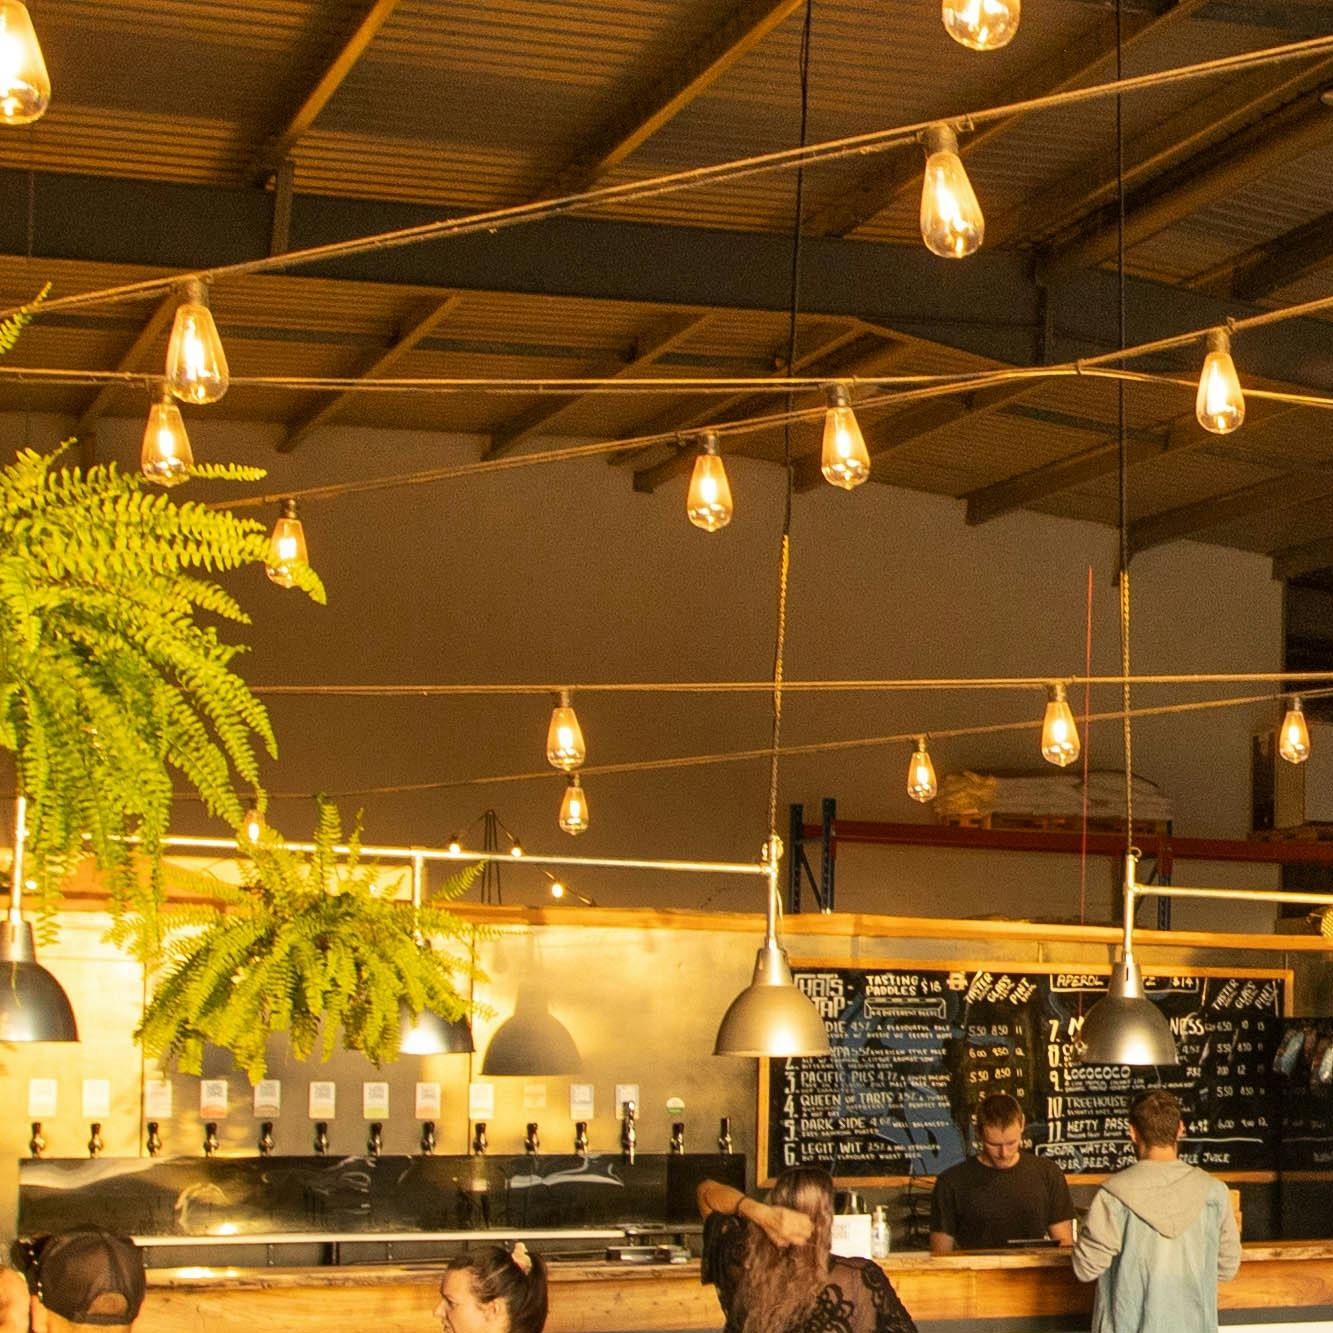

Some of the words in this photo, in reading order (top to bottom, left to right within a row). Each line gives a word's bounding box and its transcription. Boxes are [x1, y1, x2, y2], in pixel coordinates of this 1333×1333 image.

[866, 975, 919, 986] TASTING
[1056, 975, 1104, 987] APEROL
[866, 986, 917, 996] PADDLES
[964, 972, 994, 1004] TASTER
[987, 975, 1011, 1003] GLASS
[1009, 977, 1030, 1005] PINT
[1211, 979, 1239, 1010] TASTER
[1254, 983, 1273, 1009] PINT
[801, 1071, 847, 1084] PACIFIC
[852, 1071, 876, 1082] PILS
[801, 1094, 841, 1106] QUEEN
[859, 1092, 894, 1105] TARTS
[1066, 1096, 1128, 1109] TREEHOUSE
[801, 1118, 833, 1131] DARK
[839, 1117, 865, 1129] SIDE
[1067, 1120, 1099, 1132] HEFTY
[801, 1142, 836, 1154] LEGIT
[839, 1142, 862, 1153] WIT
[1045, 1144, 1075, 1156] SODA
[1202, 1152, 1230, 1163] JUICE
